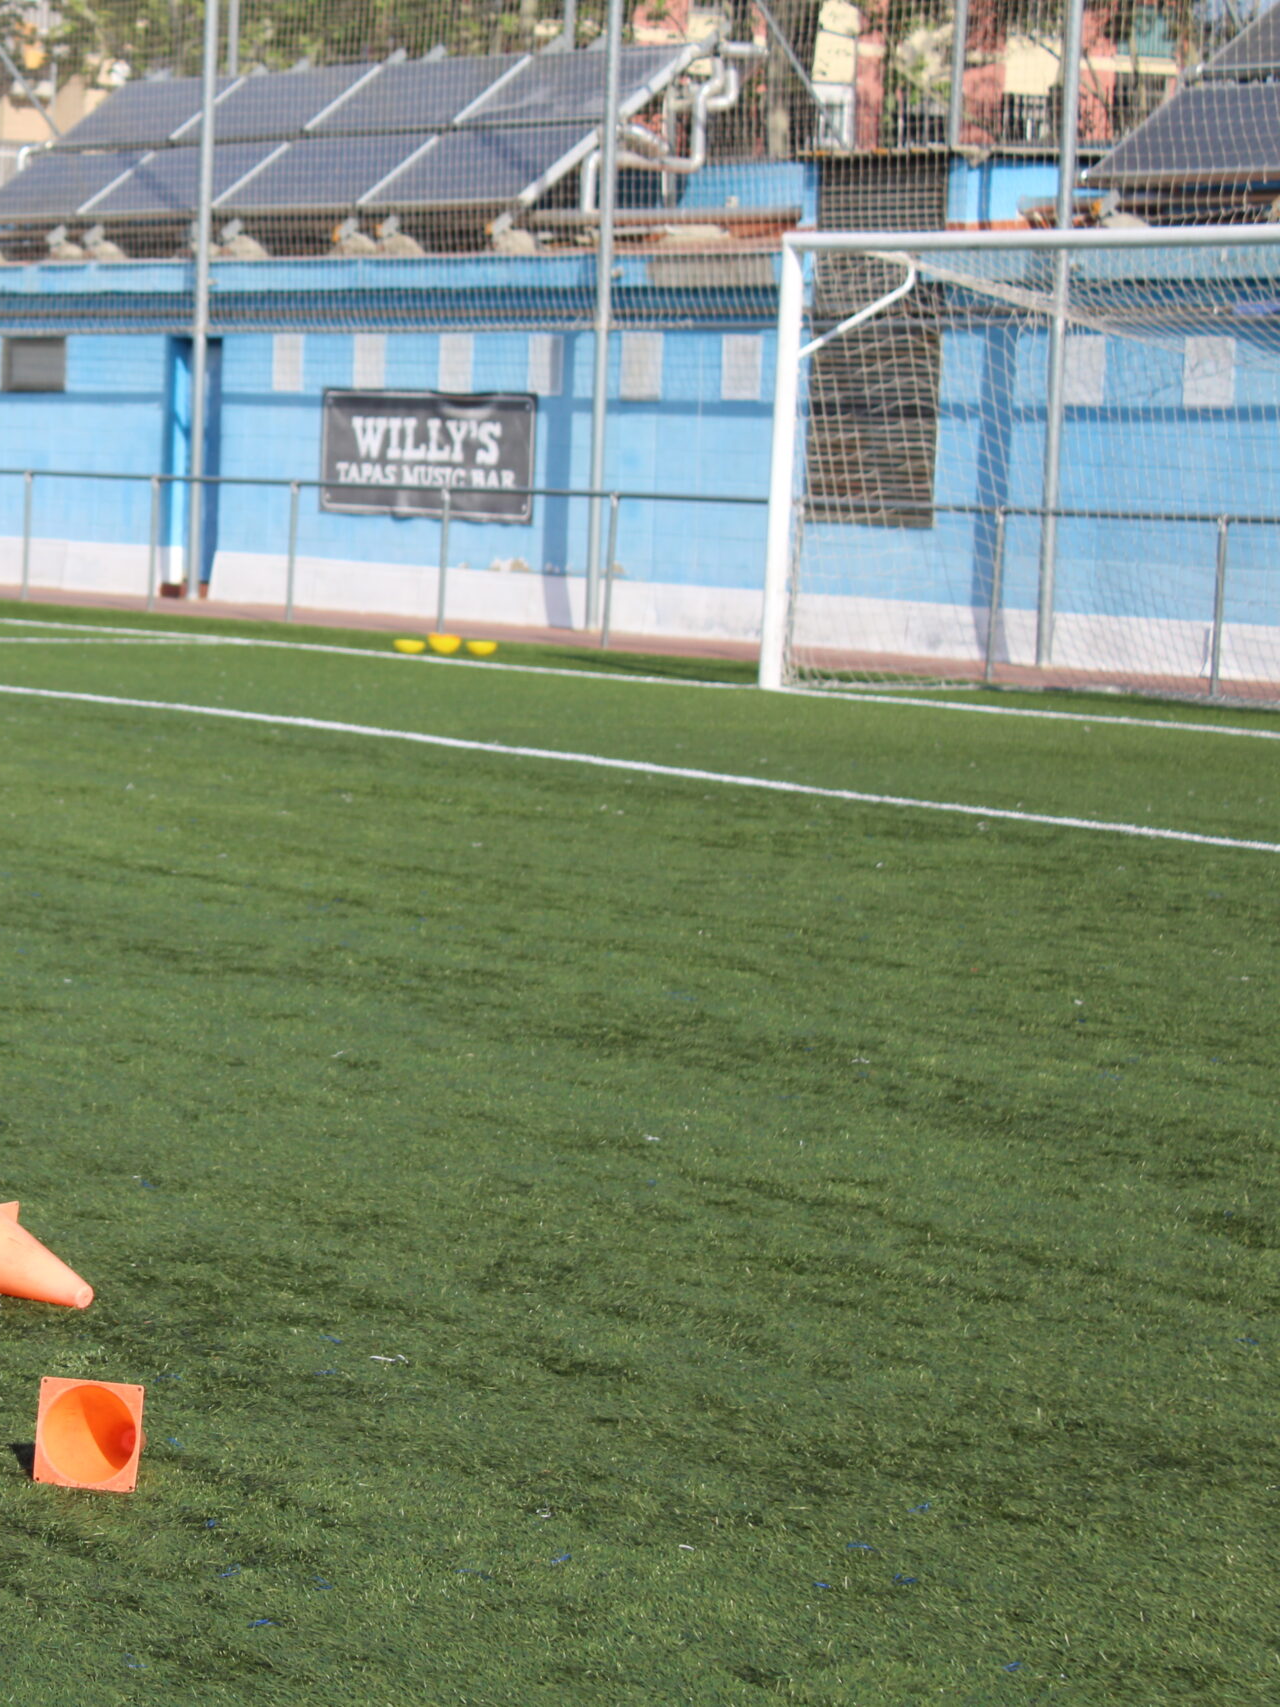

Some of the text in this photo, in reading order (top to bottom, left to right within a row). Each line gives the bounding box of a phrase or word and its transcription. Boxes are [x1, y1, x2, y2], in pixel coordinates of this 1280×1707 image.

[352, 417, 501, 464] WILLY'S
[336, 462, 516, 489] TAPAS MUSIC BAR
